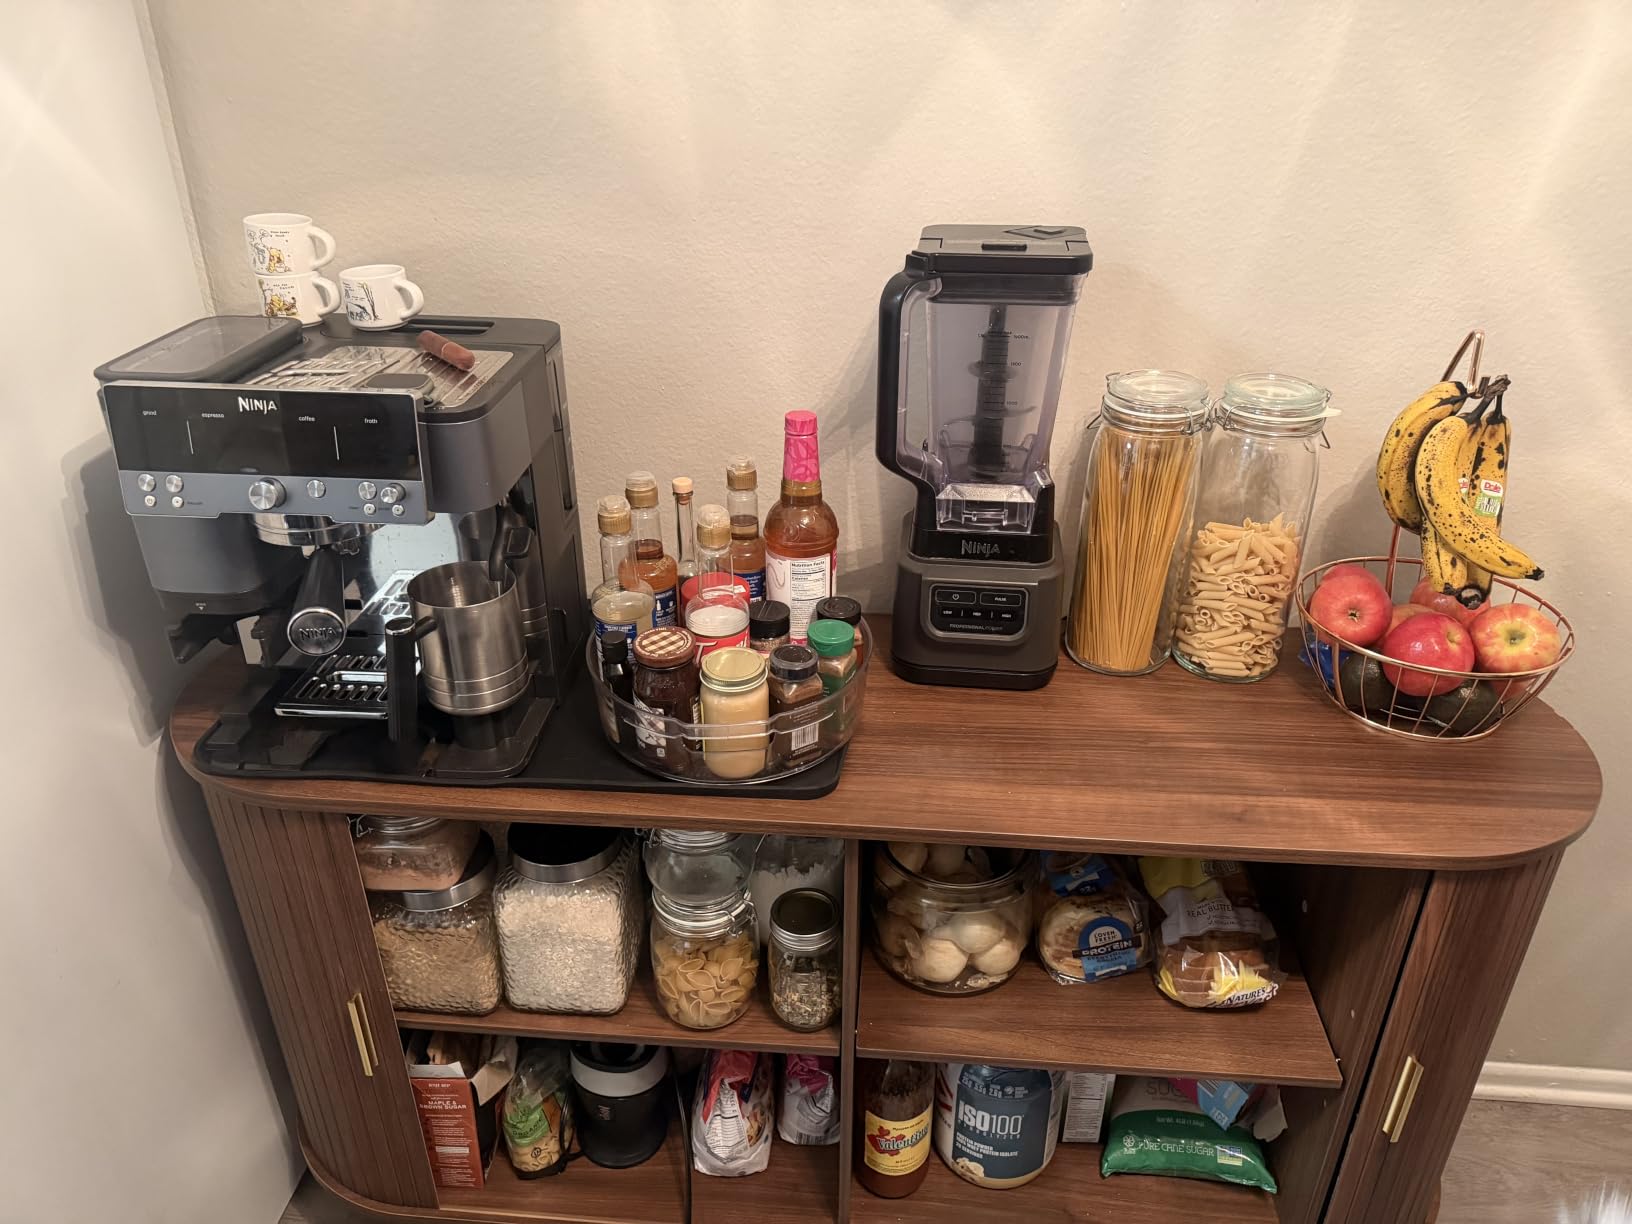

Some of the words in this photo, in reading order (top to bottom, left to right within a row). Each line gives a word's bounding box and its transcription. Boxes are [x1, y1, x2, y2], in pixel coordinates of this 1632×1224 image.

[237, 396, 278, 414] NINJA
[961, 539, 1001, 558] NINJA
[299, 627, 337, 641] NINJA
[1208, 903, 1233, 913] BUTTE
[1081, 940, 1132, 957] PROTEIN
[1137, 1141, 1161, 1151] PURE
[1161, 1143, 1185, 1153] CANE
[1185, 1145, 1215, 1157] SUGAR
